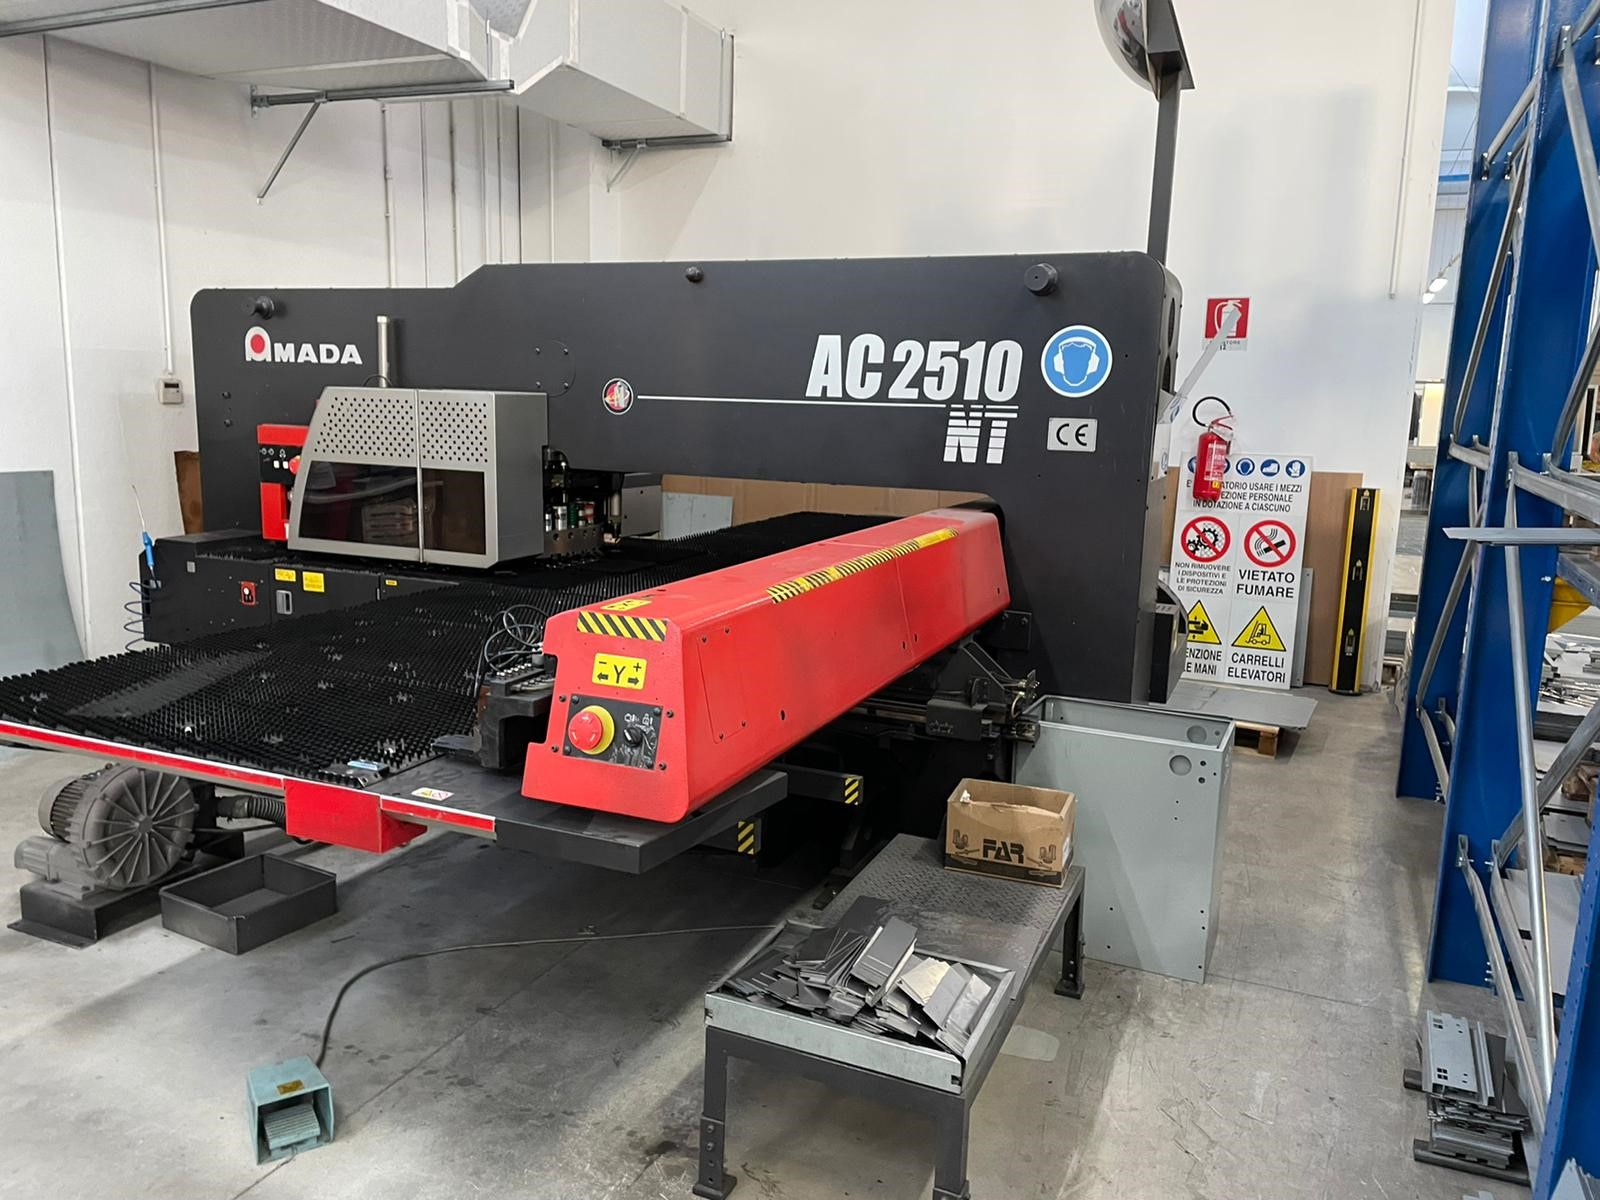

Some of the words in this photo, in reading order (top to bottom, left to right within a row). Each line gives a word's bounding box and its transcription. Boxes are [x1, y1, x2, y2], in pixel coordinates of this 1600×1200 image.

[245, 326, 363, 364] AMADA
[805, 333, 885, 399] AC
[888, 340, 1023, 401] 2510
[943, 404, 1019, 464] NT
[1056, 424, 1089, 446] CE
[1249, 482, 1274, 492] USARE
[1280, 484, 1302, 493] MEZZI
[1220, 491, 1247, 501] EZIONE
[1248, 493, 1293, 503] PERSONALE
[1193, 500, 1200, 508] IN
[1202, 500, 1243, 510] DOTAZIONE
[1244, 503, 1250, 511] A
[1251, 503, 1290, 513] CIASCUNO
[1181, 570, 1221, 578] DISPOSITIVI
[1191, 563, 1231, 571] RIMUOVERE
[1186, 578, 1227, 587] PROTEZIONI
[1239, 569, 1295, 583] VIETATO
[1186, 586, 1223, 594] SICUREZZA
[1236, 583, 1294, 598] FUMARE
[1186, 648, 1222, 661] ENZIONE
[1232, 653, 1285, 668] CARRELLI
[614, 664, 626, 684] Y
[1194, 662, 1217, 676] MANI
[1228, 667, 1286, 683] ELEVATORI
[983, 838, 1024, 864] FAR
